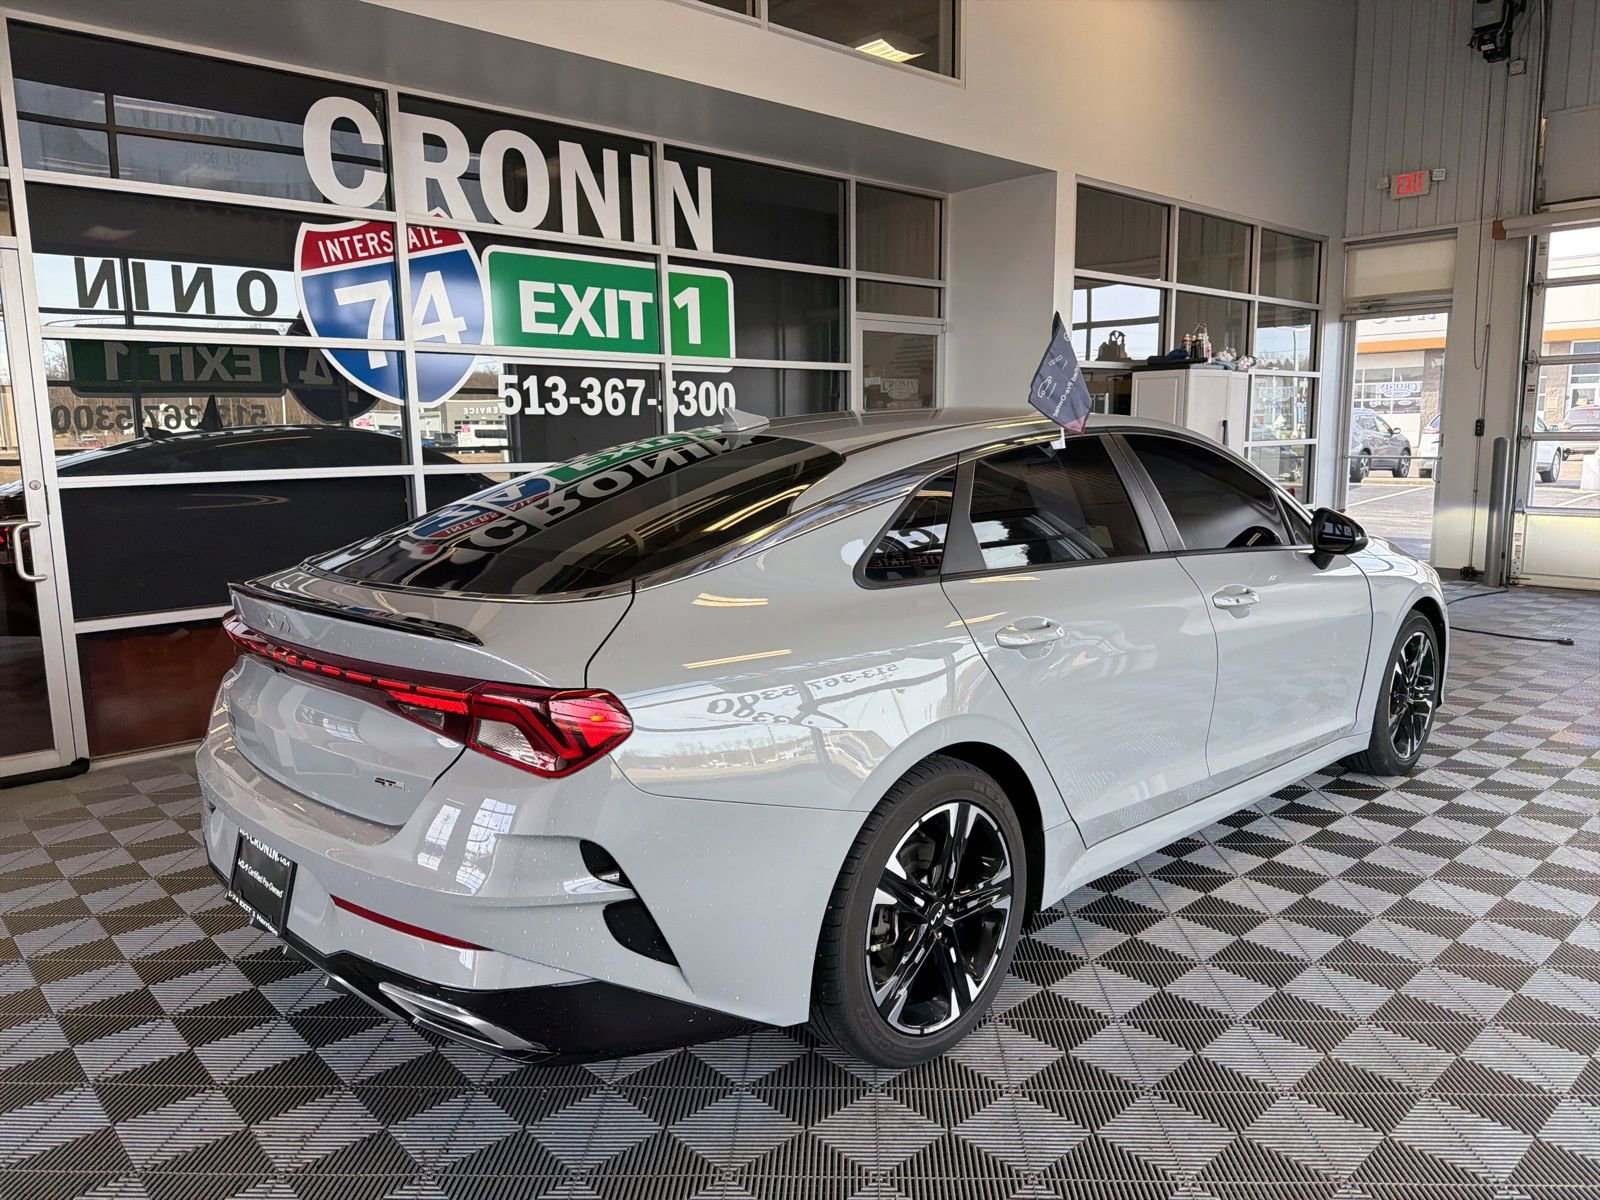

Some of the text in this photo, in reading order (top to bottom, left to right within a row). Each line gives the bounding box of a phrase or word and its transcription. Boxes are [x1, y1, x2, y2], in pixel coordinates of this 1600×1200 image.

[303, 96, 713, 253] CRONIN
[1397, 172, 1424, 195] EXIT
[318, 226, 443, 263] INTERSATE
[335, 270, 467, 370] 74
[519, 279, 701, 345] EXIT 1
